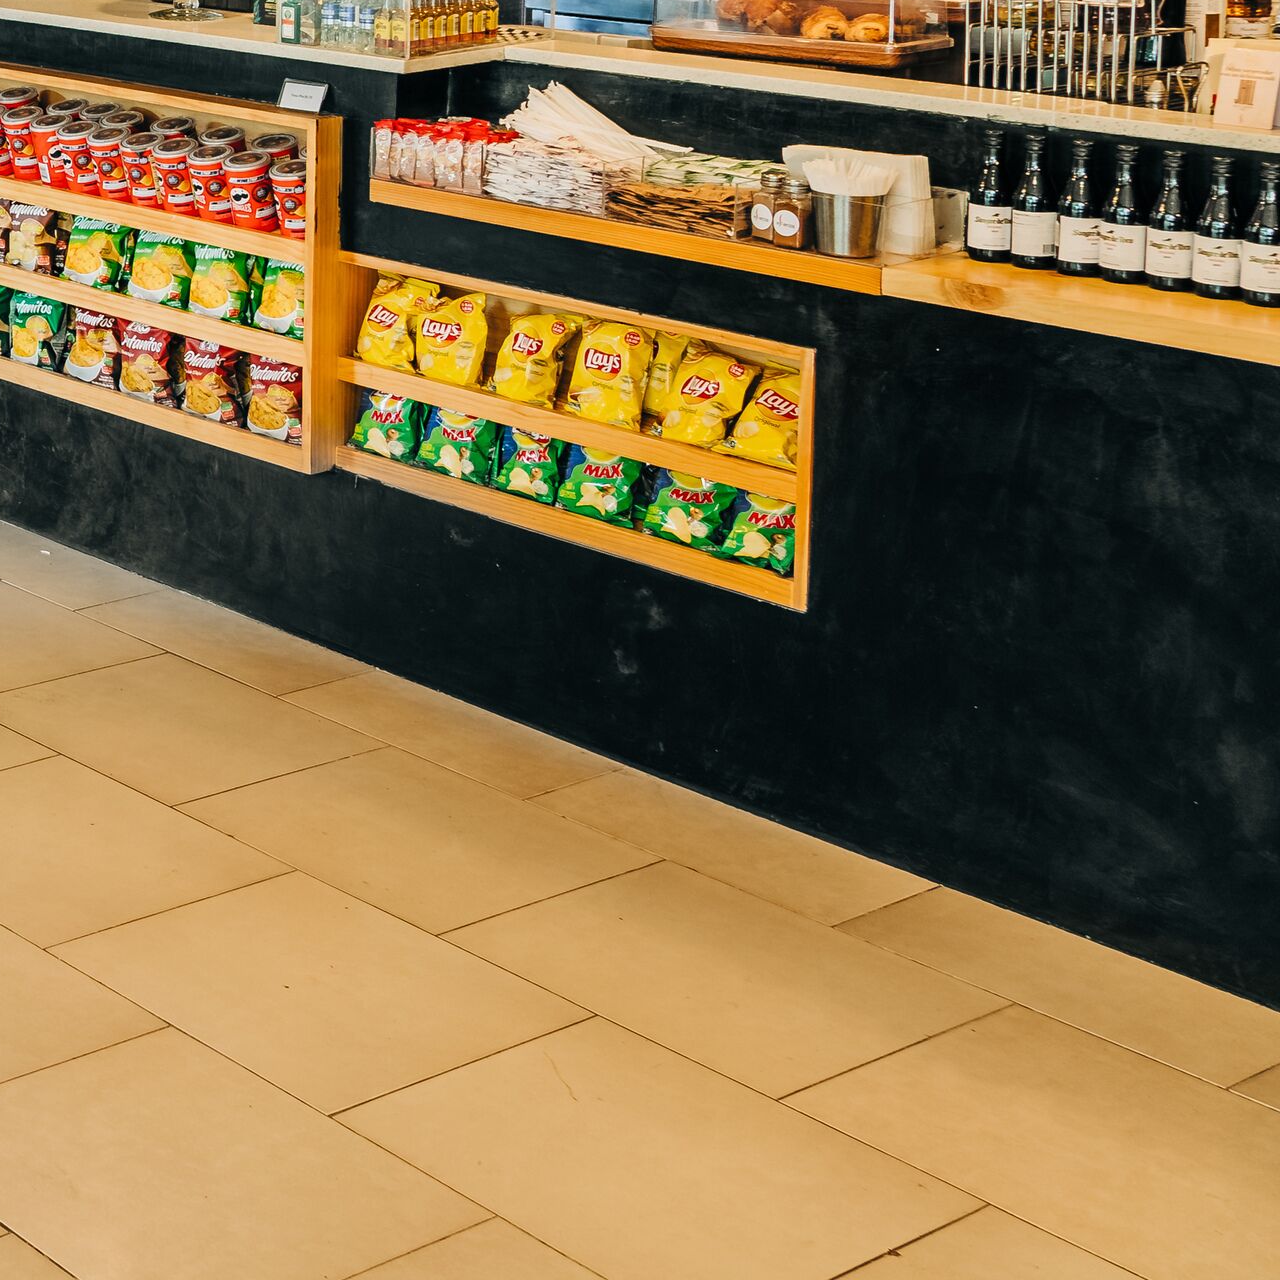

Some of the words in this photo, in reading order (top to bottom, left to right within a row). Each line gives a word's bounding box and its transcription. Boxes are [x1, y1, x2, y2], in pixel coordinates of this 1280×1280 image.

[422, 317, 463, 339] Lay's
[586, 349, 621, 373] Lay's
[371, 409, 405, 425] MAX
[442, 426, 476, 443] MAX
[583, 462, 625, 480] MAX
[670, 487, 717, 505] MAX
[748, 511, 796, 530] MAX
